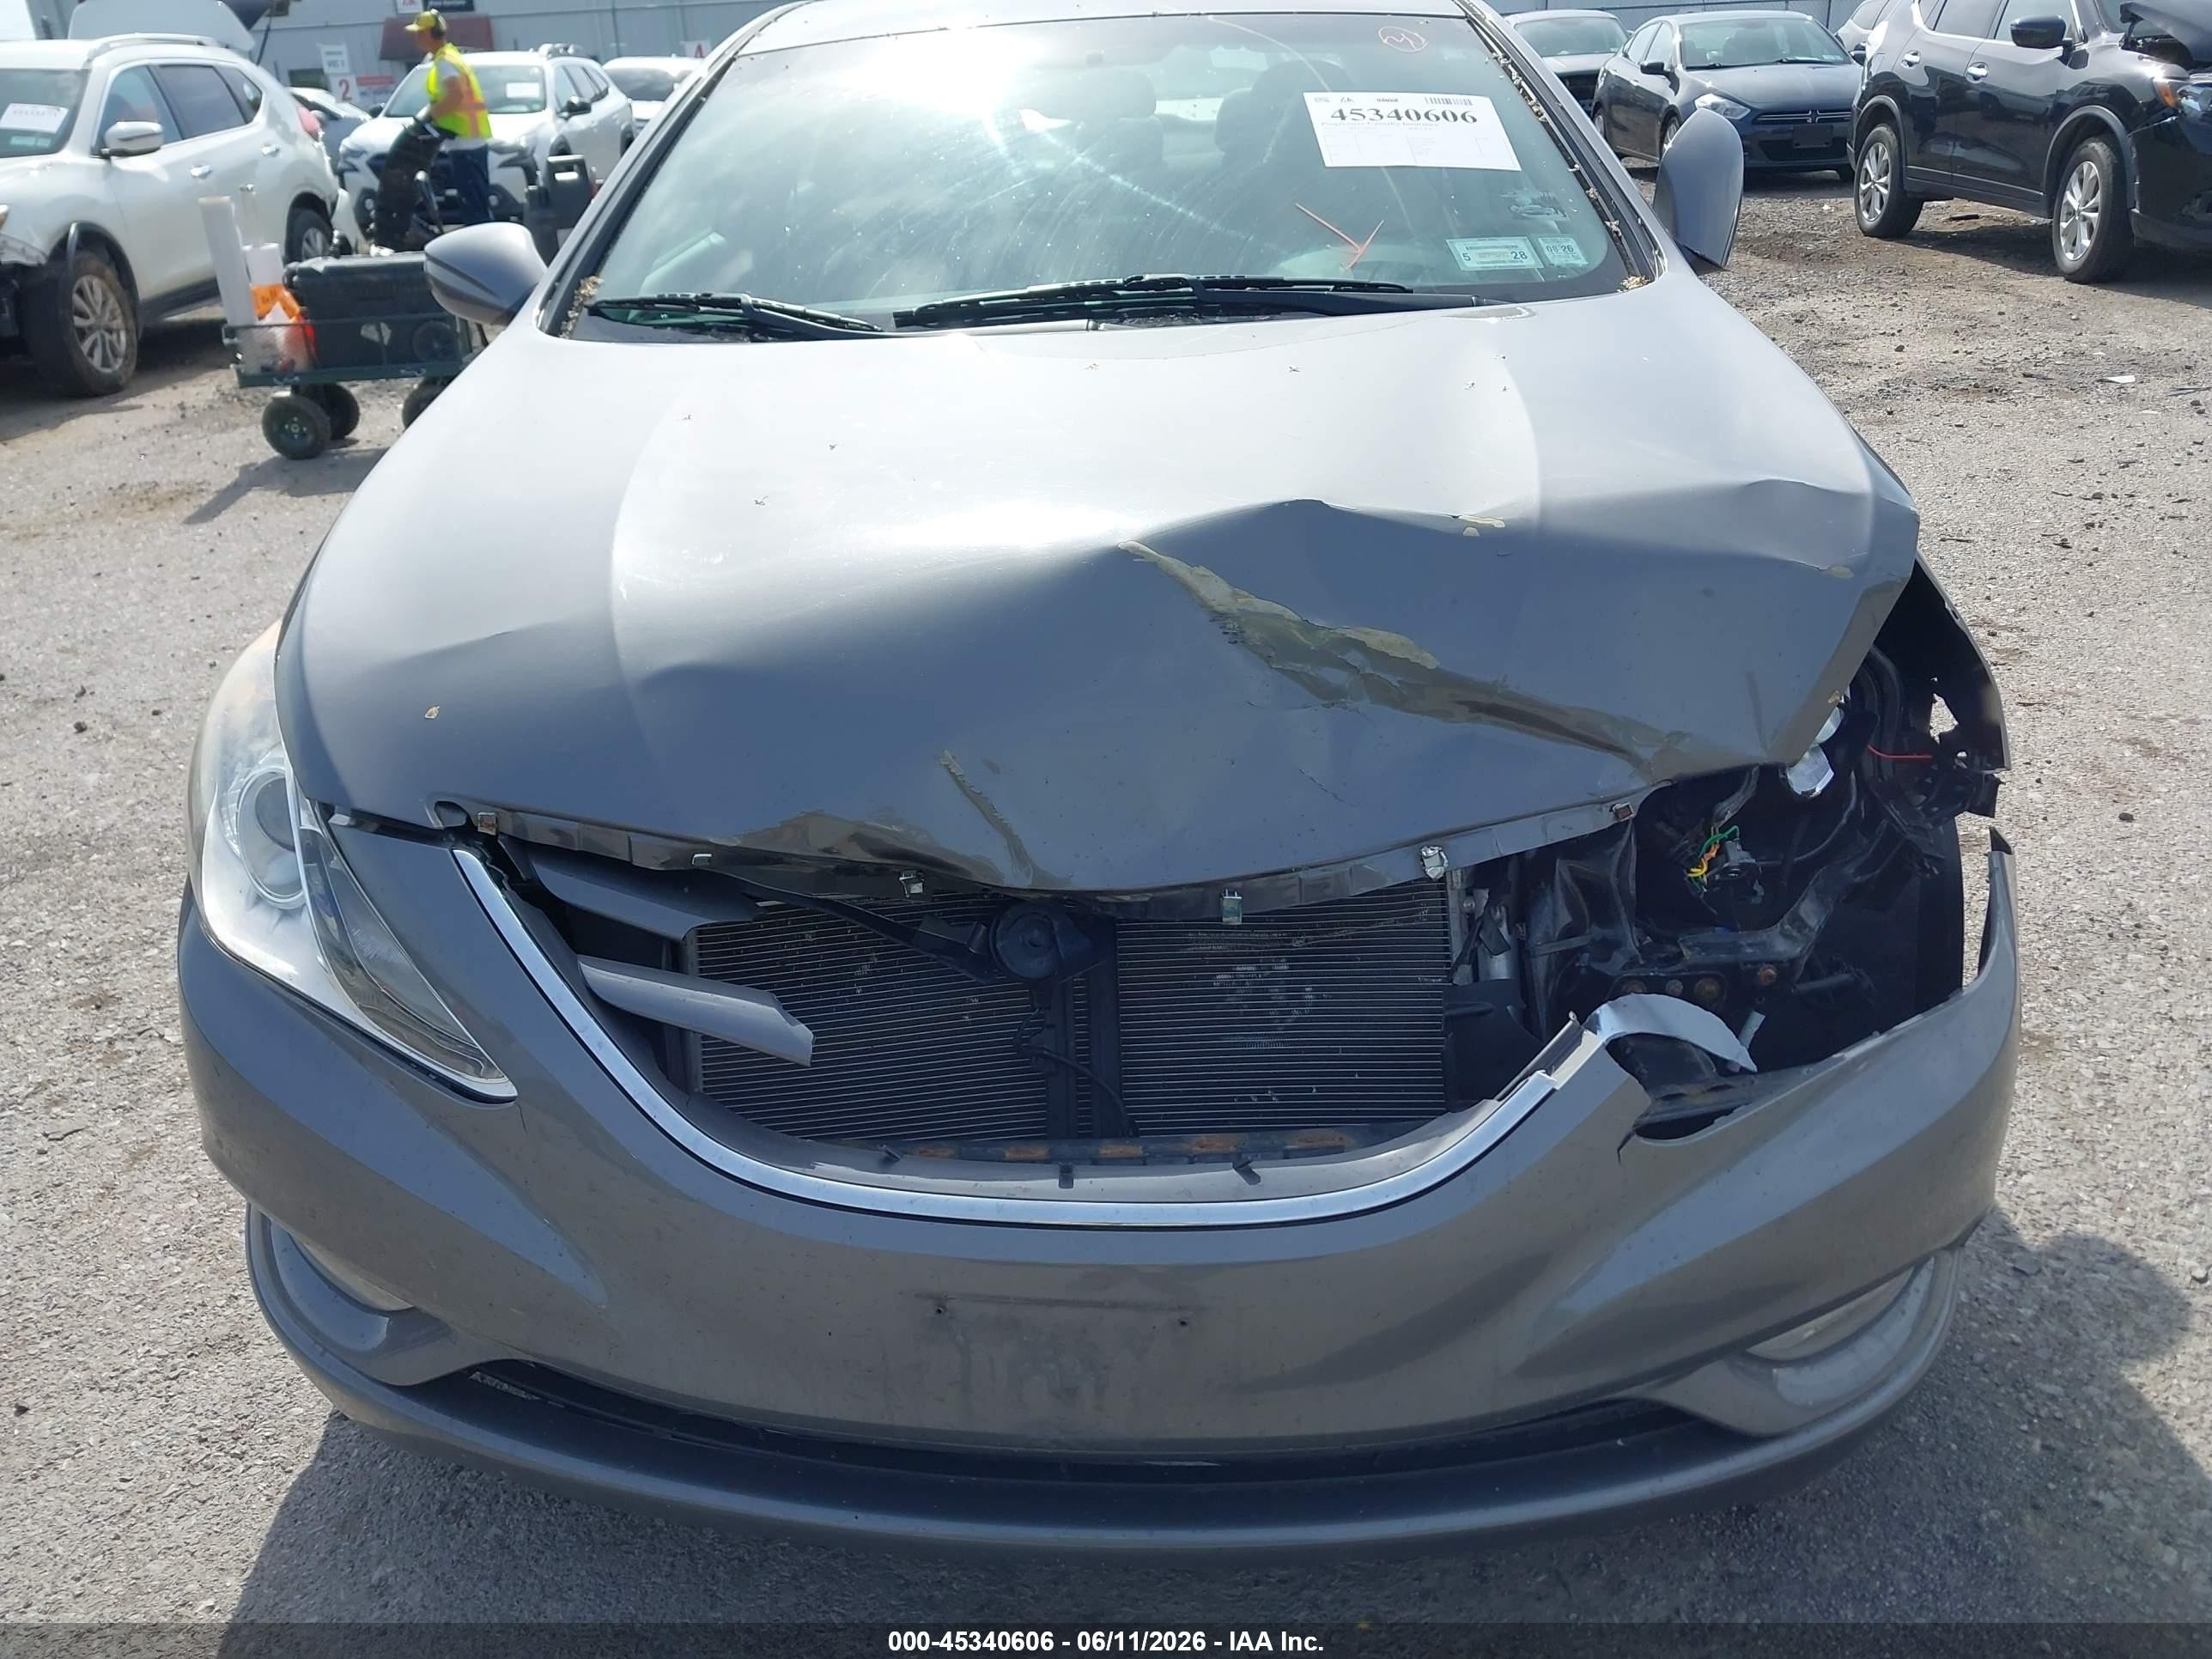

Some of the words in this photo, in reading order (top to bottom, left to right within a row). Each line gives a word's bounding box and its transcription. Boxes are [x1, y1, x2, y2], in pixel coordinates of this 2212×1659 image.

[339, 78, 352, 101] 2
[1330, 107, 1478, 124] 45340606
[1462, 252, 1471, 262] 5
[1510, 251, 1528, 260] 28
